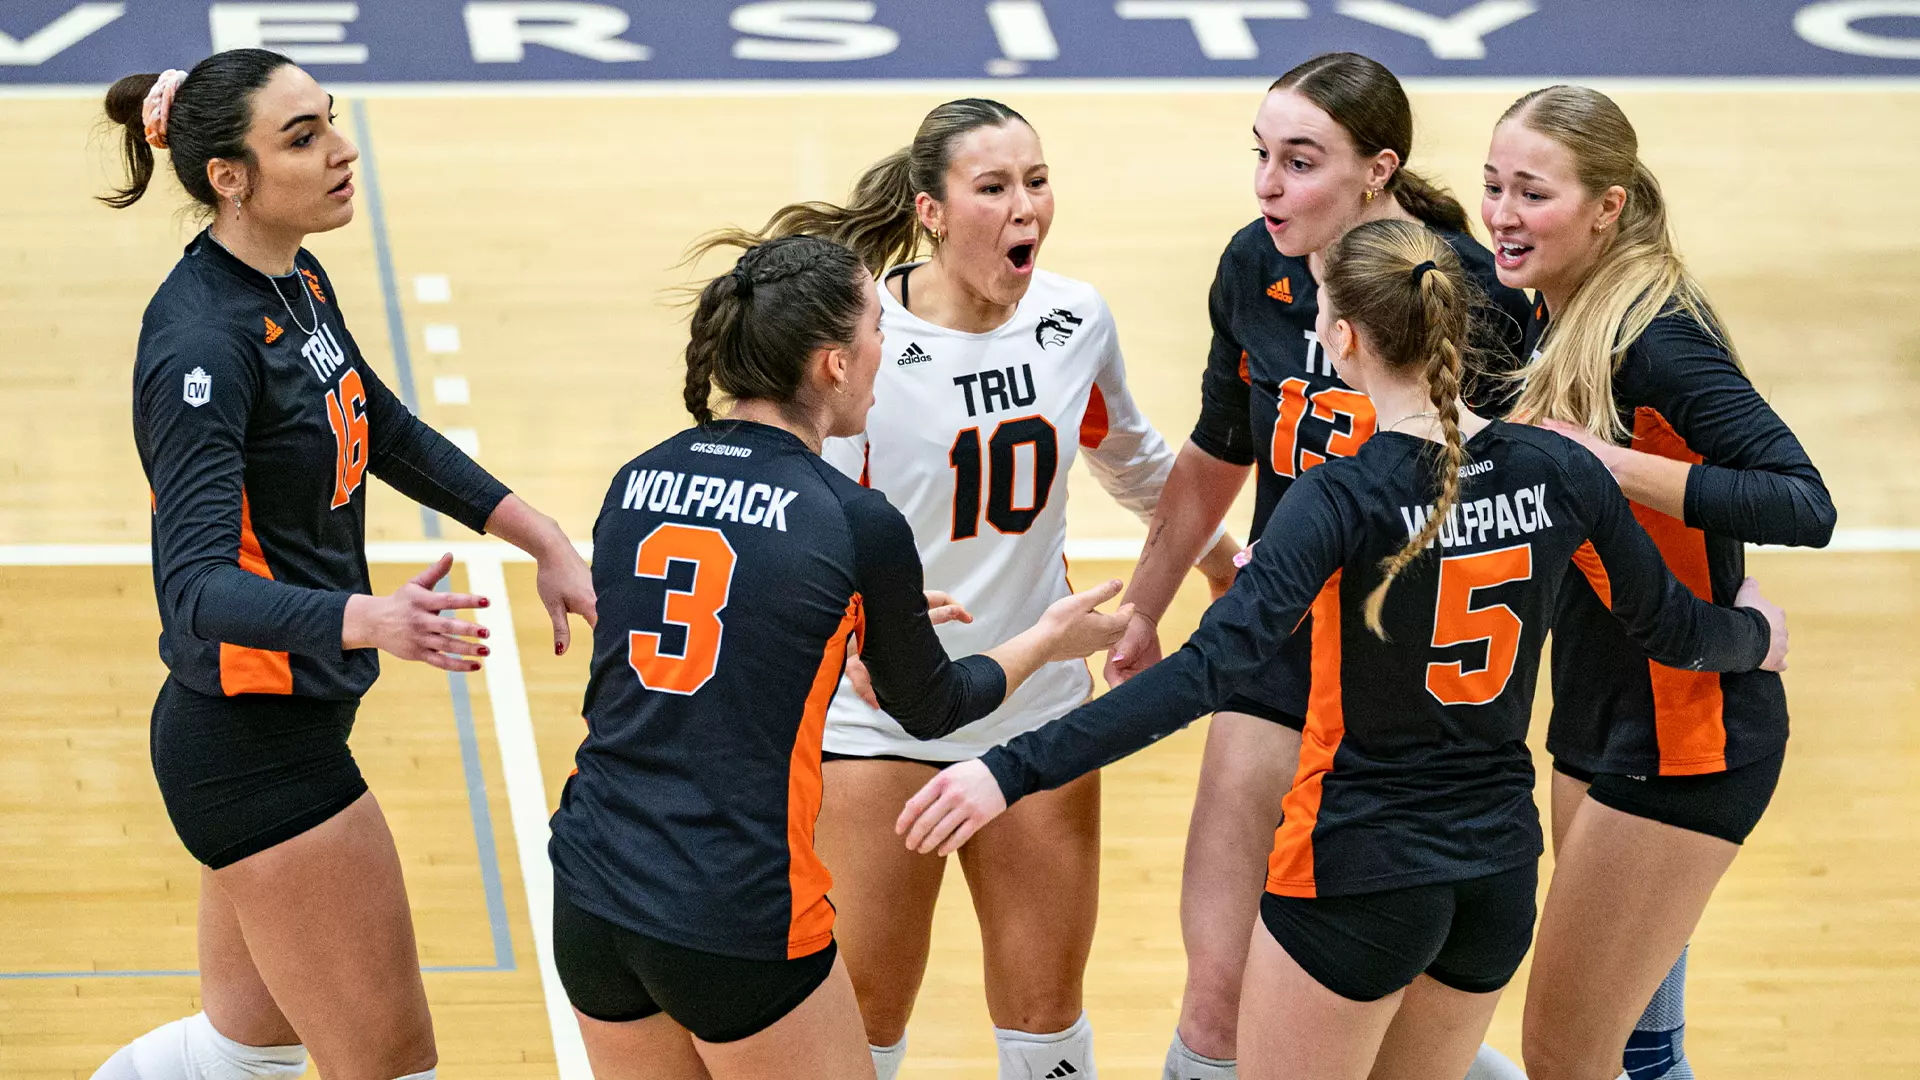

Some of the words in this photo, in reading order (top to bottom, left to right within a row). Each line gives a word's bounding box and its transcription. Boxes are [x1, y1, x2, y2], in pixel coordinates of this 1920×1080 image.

[301, 323, 345, 383] TRU
[897, 354, 932, 365] adidas
[187, 382, 207, 399] CW
[953, 363, 1037, 417] TRU
[325, 367, 369, 511] 16
[690, 442, 753, 458] GKSOUND
[1271, 376, 1378, 479] 13
[622, 469, 799, 532] WOLFPACK
[949, 414, 1059, 542] 10
[1400, 484, 1553, 549] WOLFPACK
[628, 521, 738, 696] 3
[1425, 542, 1533, 706] 5
